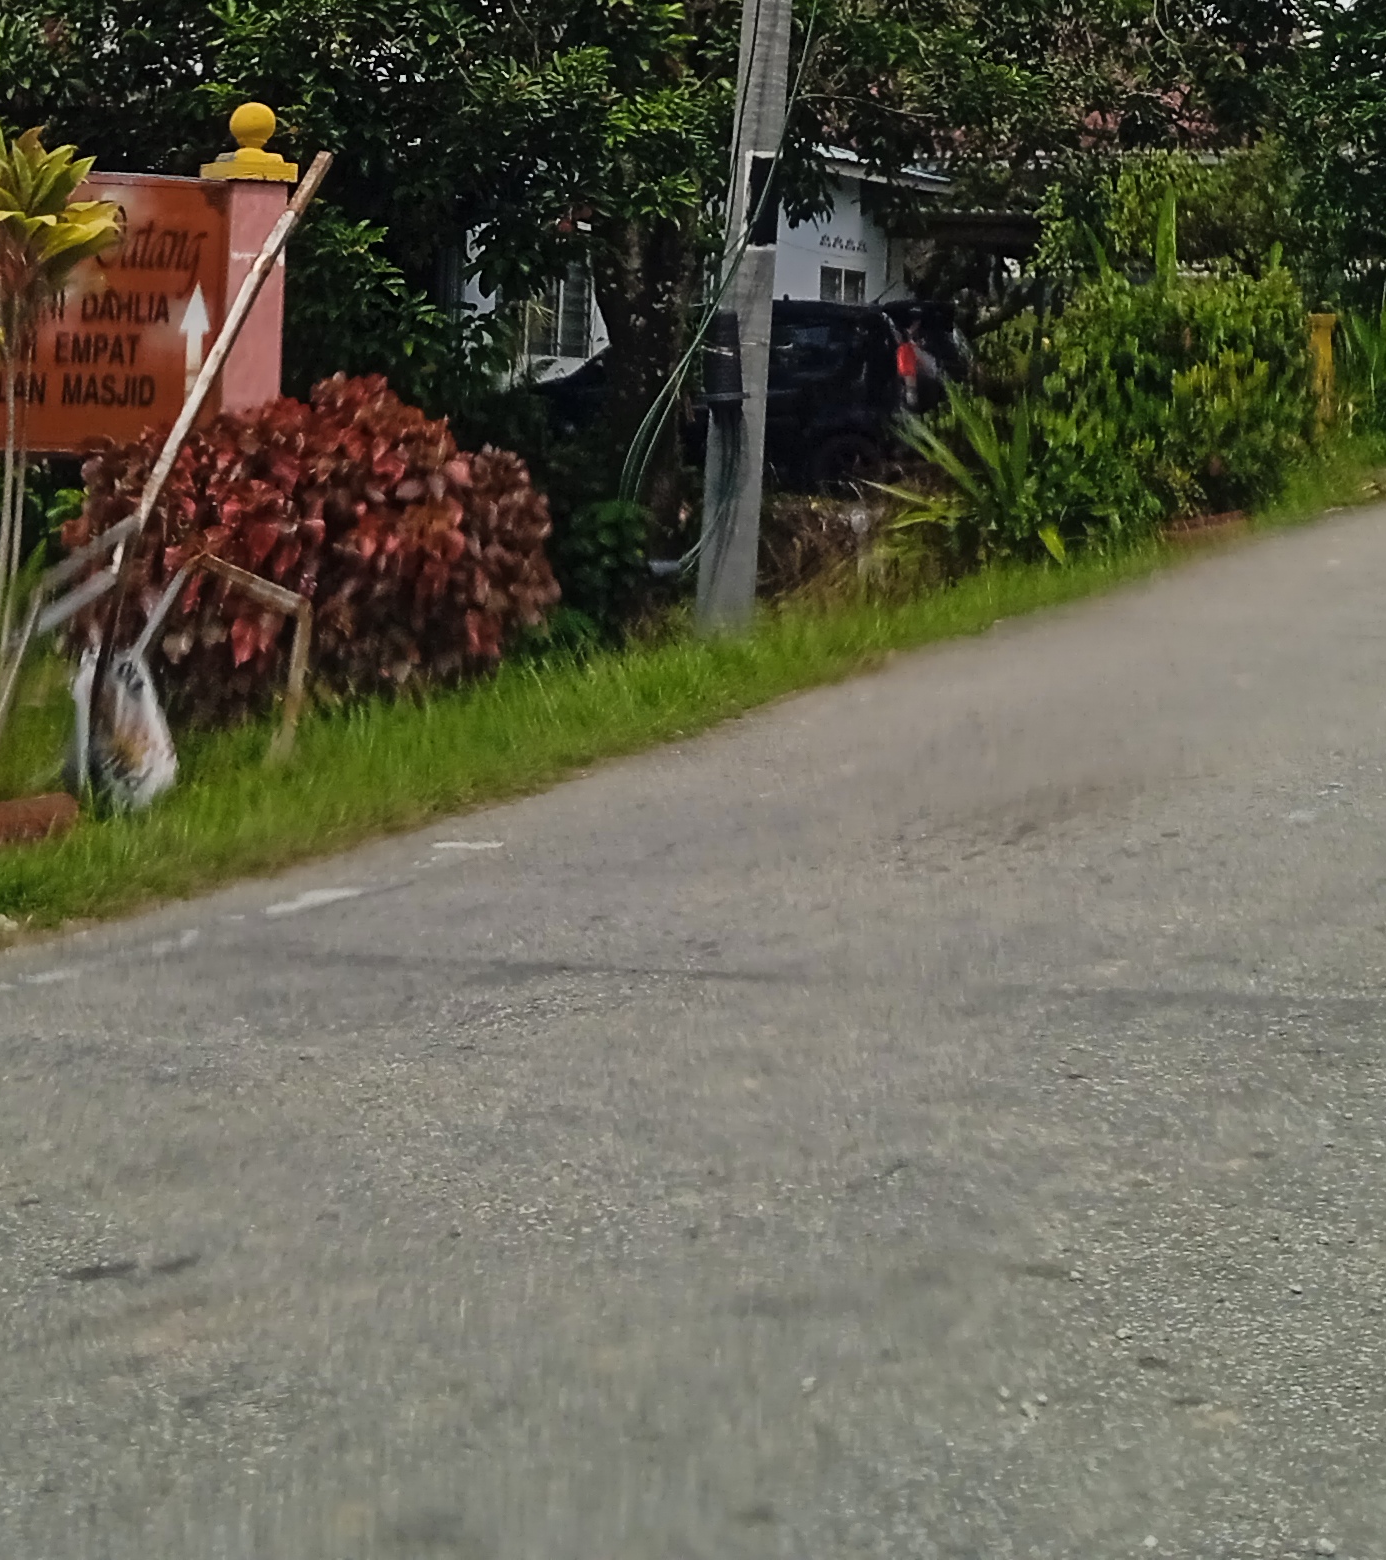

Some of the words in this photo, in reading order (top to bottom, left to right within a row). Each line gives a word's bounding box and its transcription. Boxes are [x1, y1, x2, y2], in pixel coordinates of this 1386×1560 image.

[81, 288, 170, 324] DAHLIA
[54, 330, 141, 366] EMPAT
[61, 372, 156, 407] MASJID
